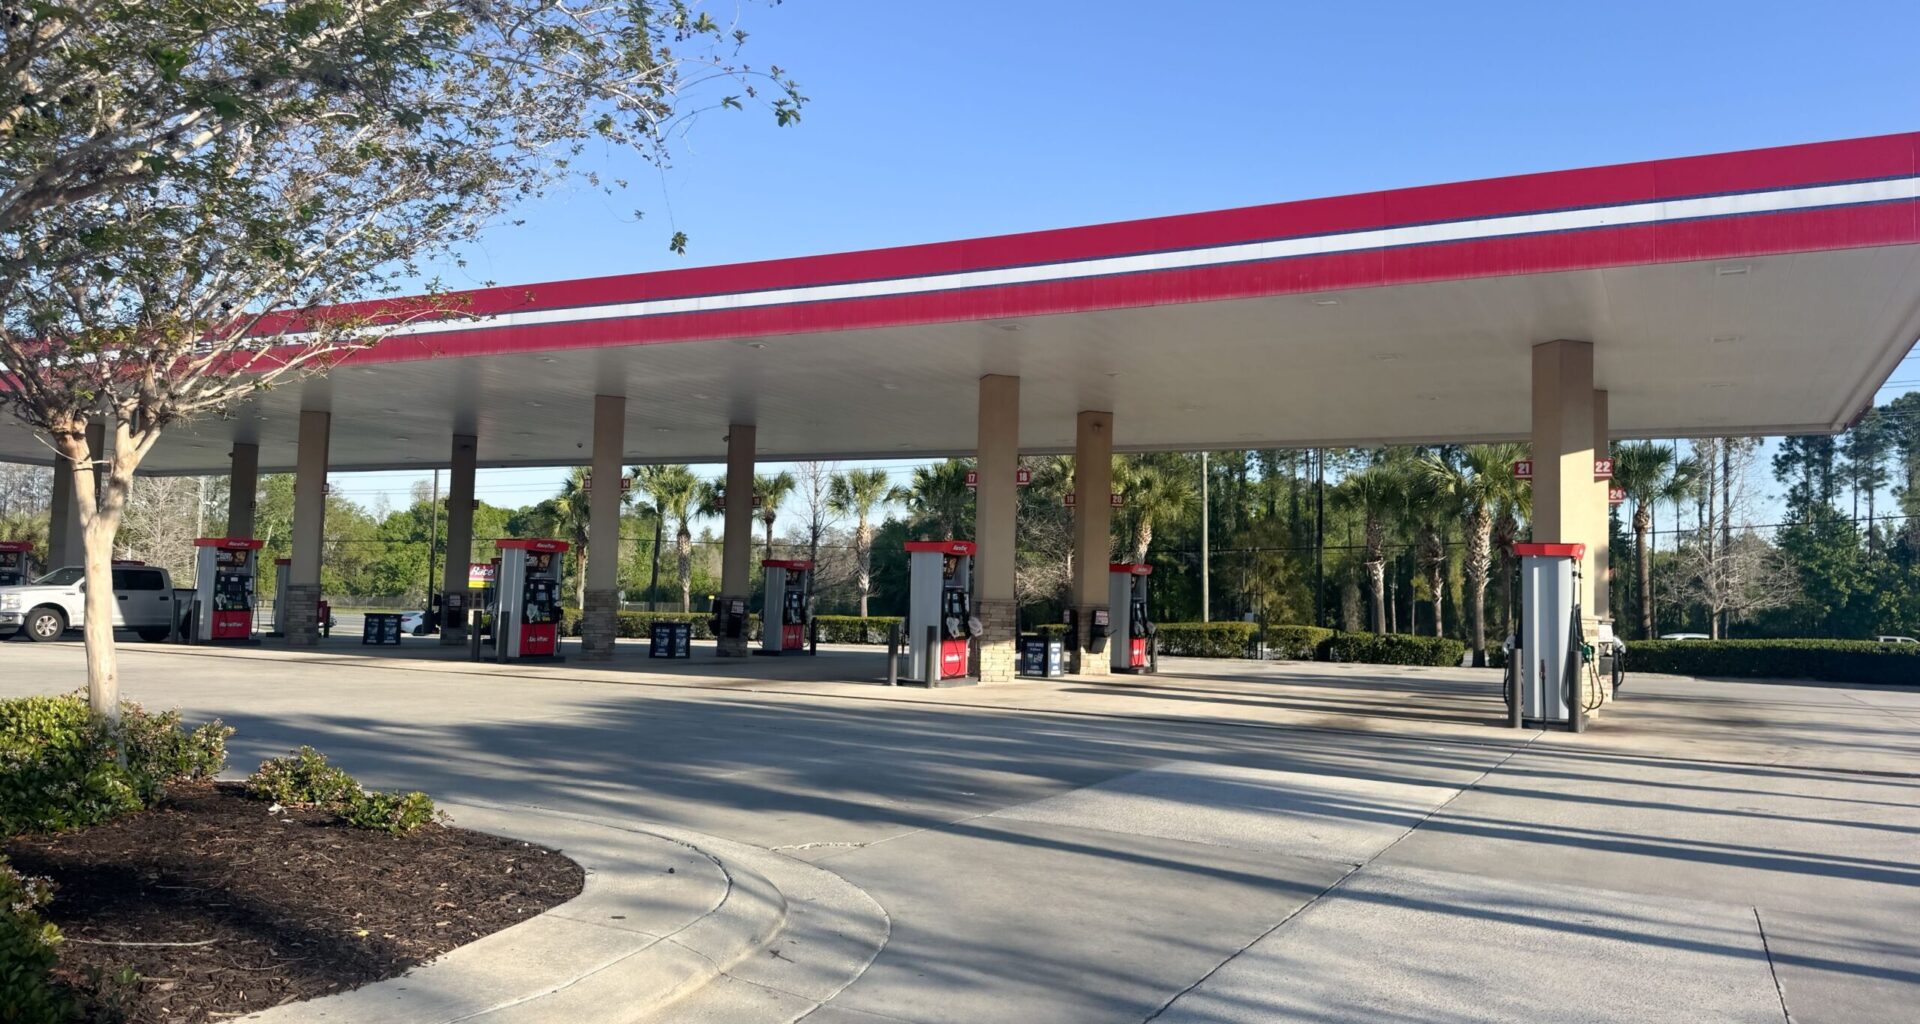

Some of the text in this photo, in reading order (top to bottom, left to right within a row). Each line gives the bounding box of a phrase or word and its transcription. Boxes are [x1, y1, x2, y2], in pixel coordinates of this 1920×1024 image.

[1517, 463, 1530, 474] 21
[1595, 461, 1610, 472] 22
[968, 473, 976, 483] 17
[1019, 472, 1028, 482] 18
[1112, 495, 1122, 503] 20
[1610, 490, 1622, 499] 24
